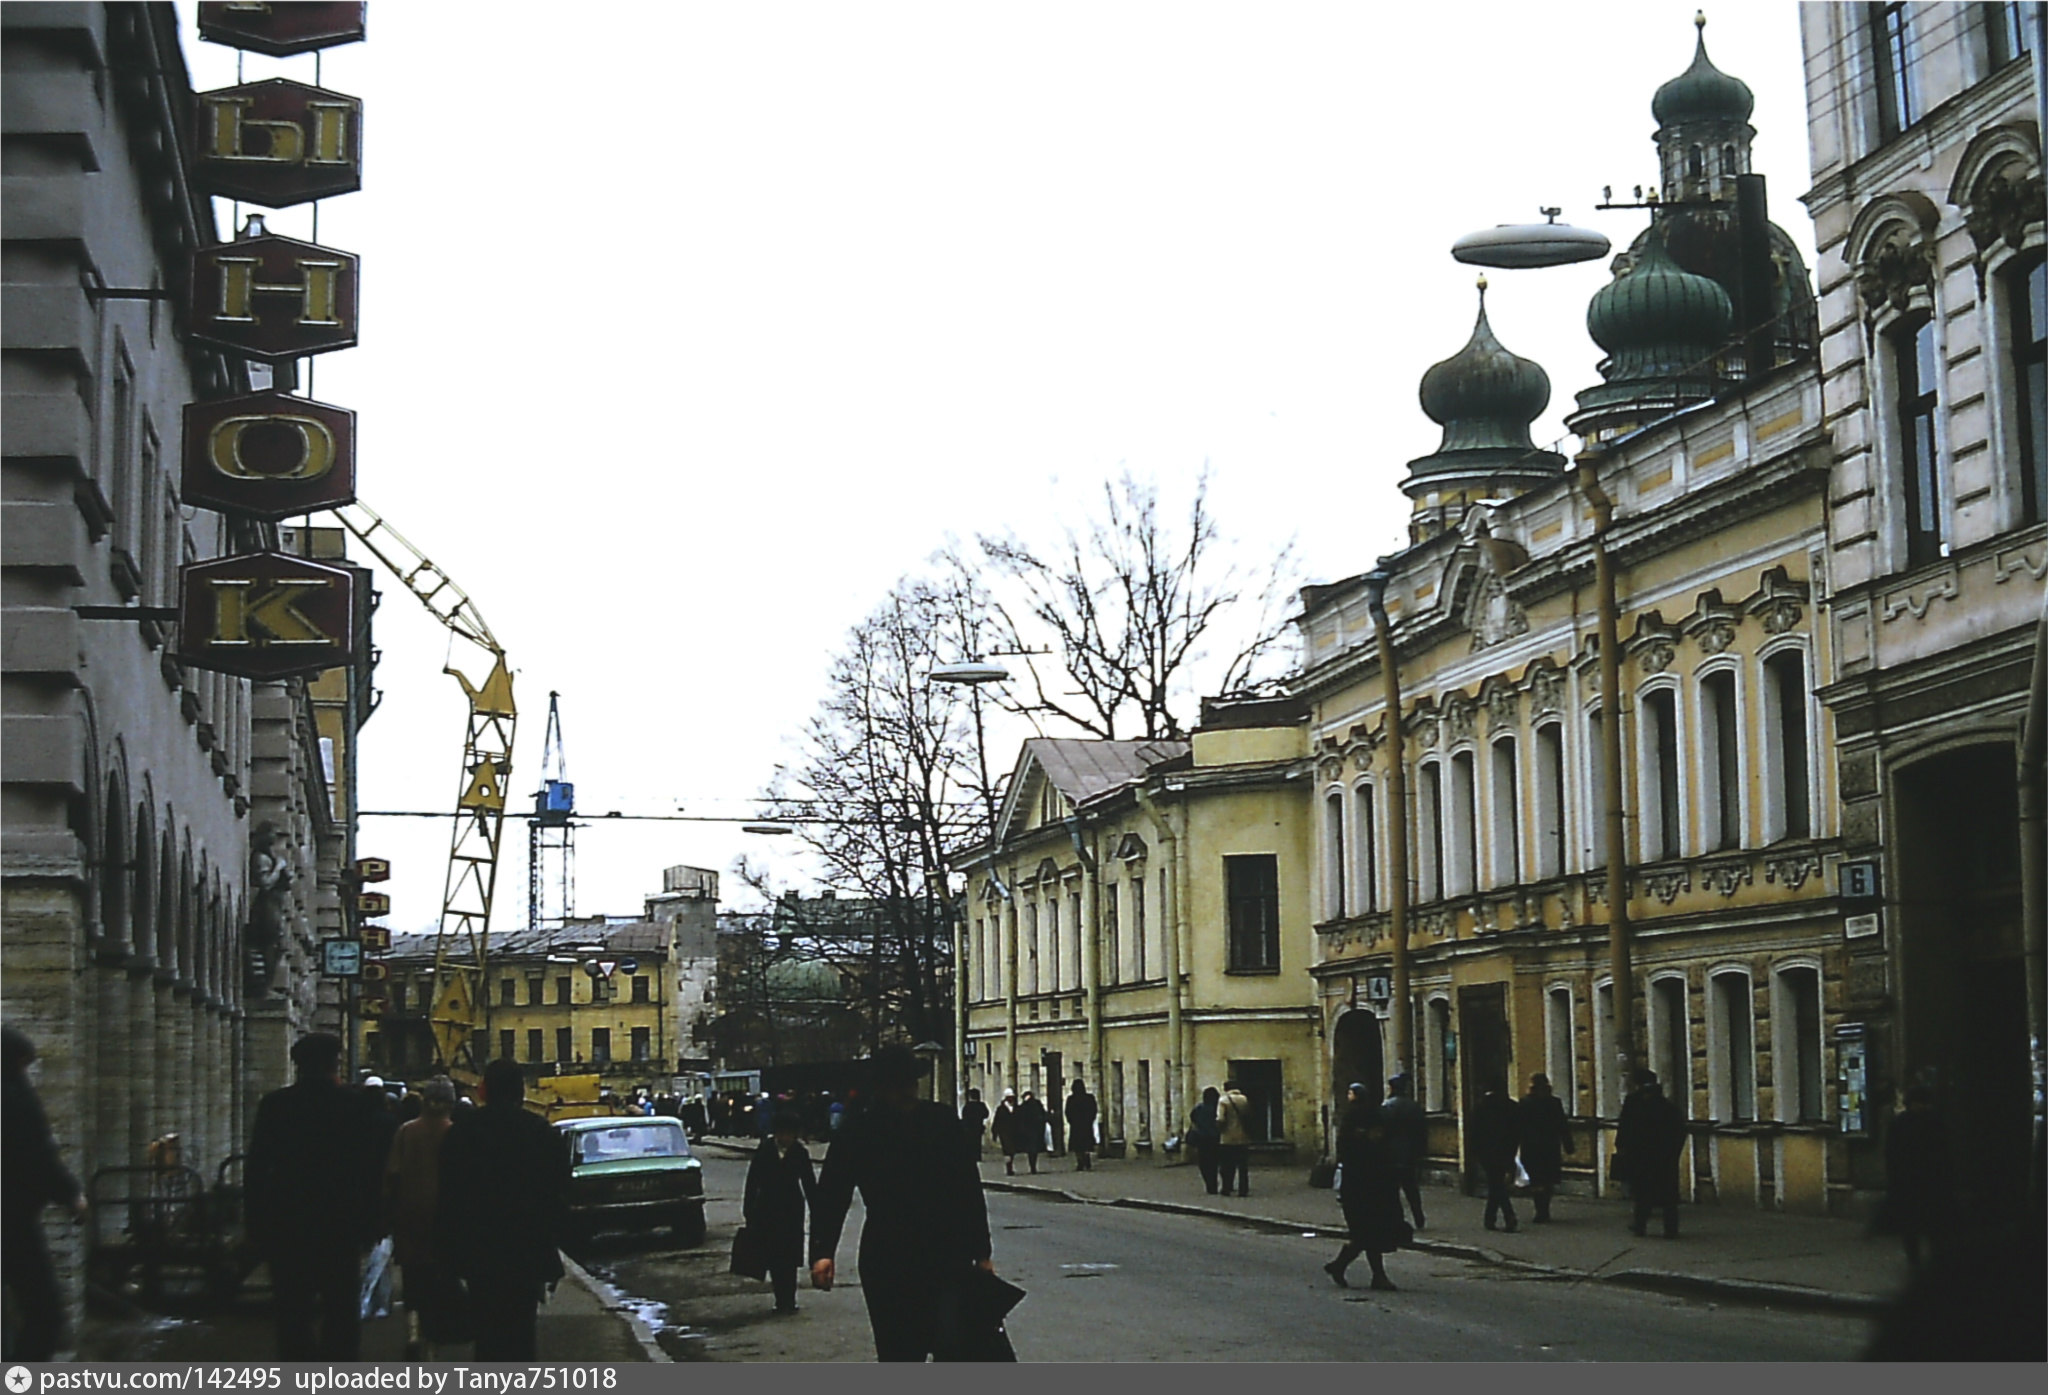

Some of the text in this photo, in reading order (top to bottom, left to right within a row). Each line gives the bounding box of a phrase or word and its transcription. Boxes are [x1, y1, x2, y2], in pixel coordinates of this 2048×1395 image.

[204, 1, 354, 648] ЫНОК
[358, 861, 388, 1014] РЫНОК
[1852, 868, 1864, 893] 6
